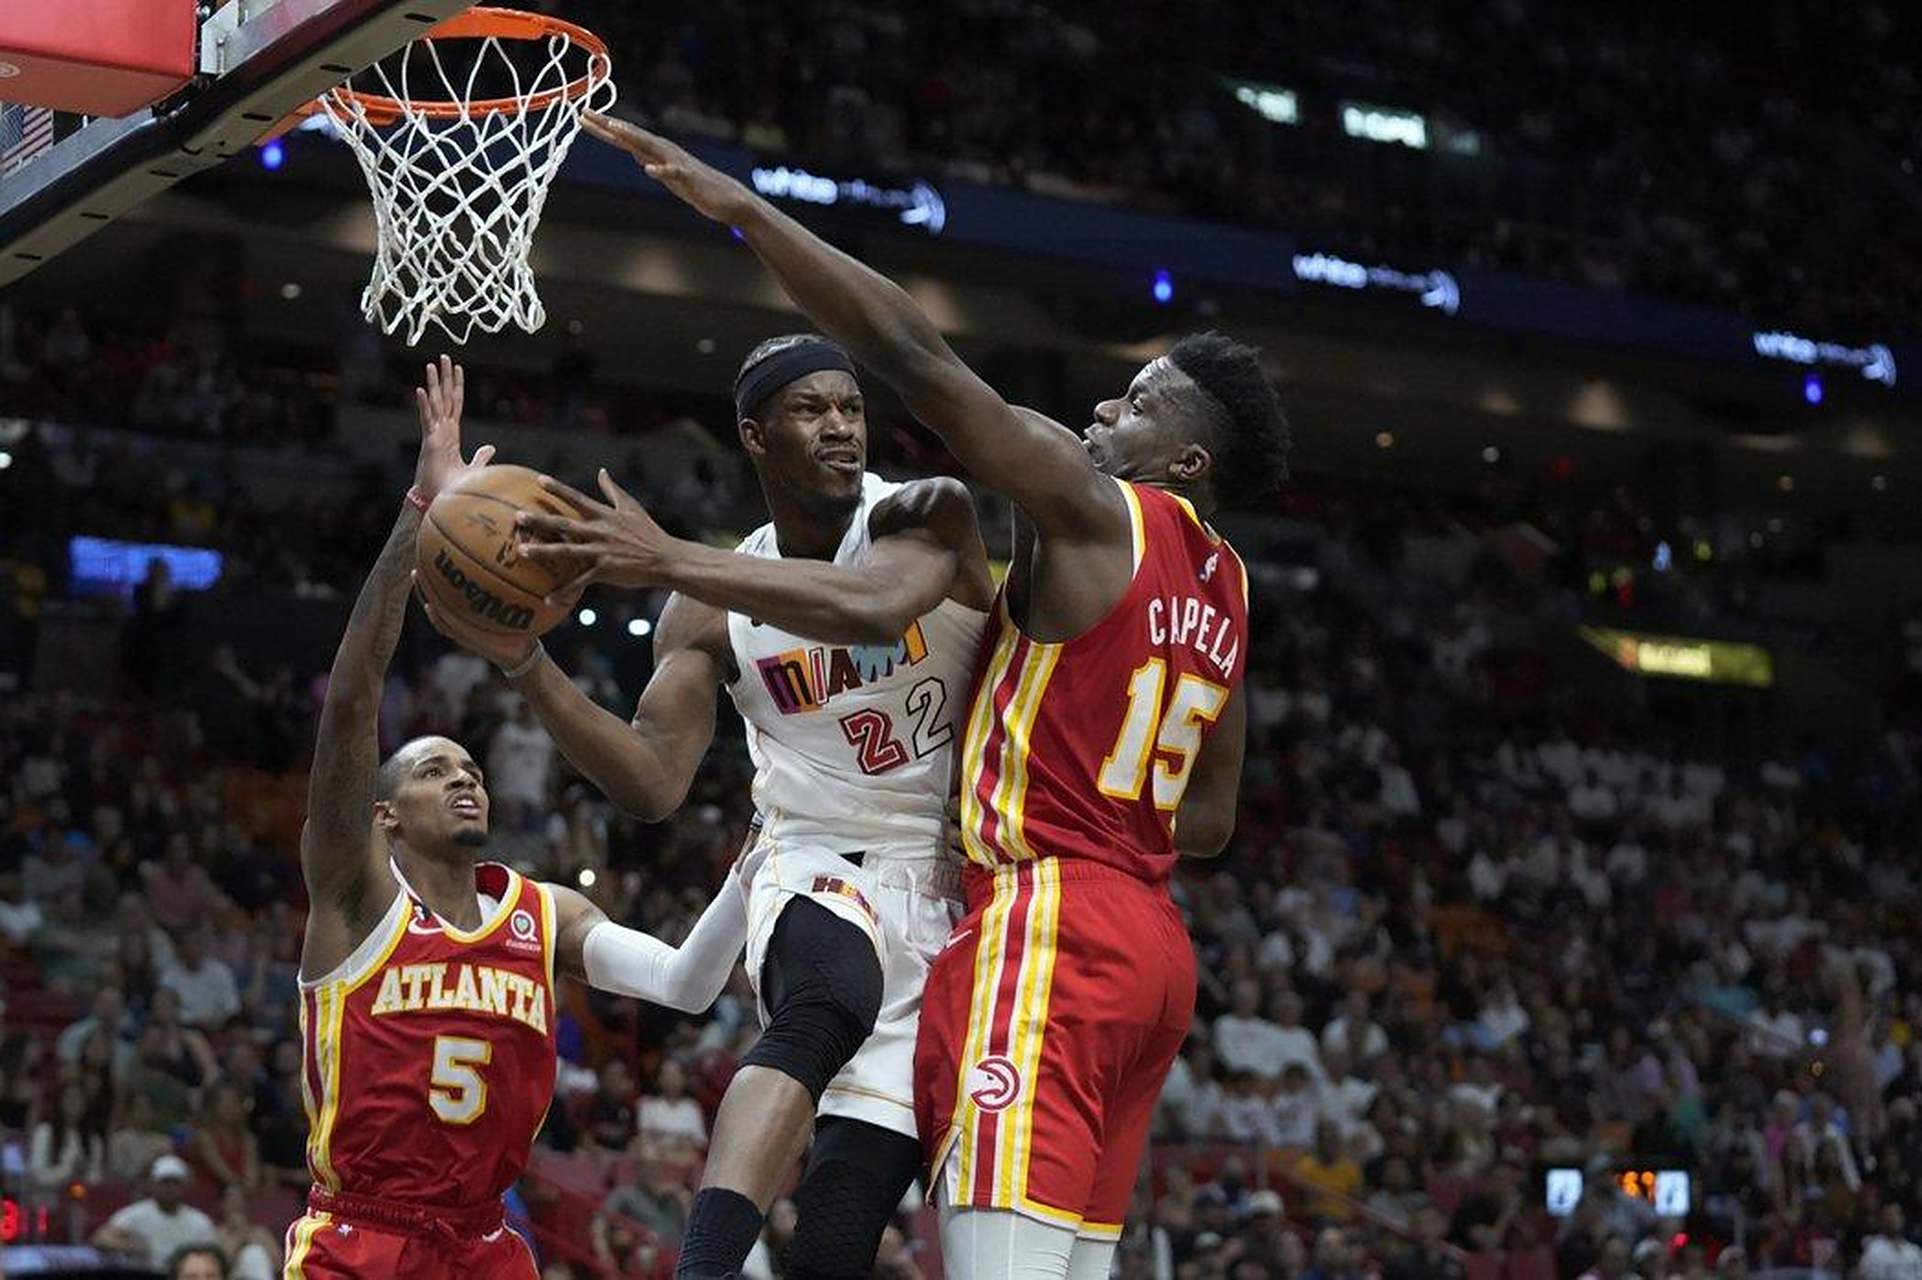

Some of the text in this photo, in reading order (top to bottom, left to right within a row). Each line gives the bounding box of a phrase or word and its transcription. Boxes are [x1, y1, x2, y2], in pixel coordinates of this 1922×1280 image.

[1148, 596, 1239, 679] CAPELA
[838, 675, 955, 776] 22
[1097, 655, 1230, 812] 15
[370, 962, 548, 1037] ATLANTA
[428, 1034, 493, 1125] 5
